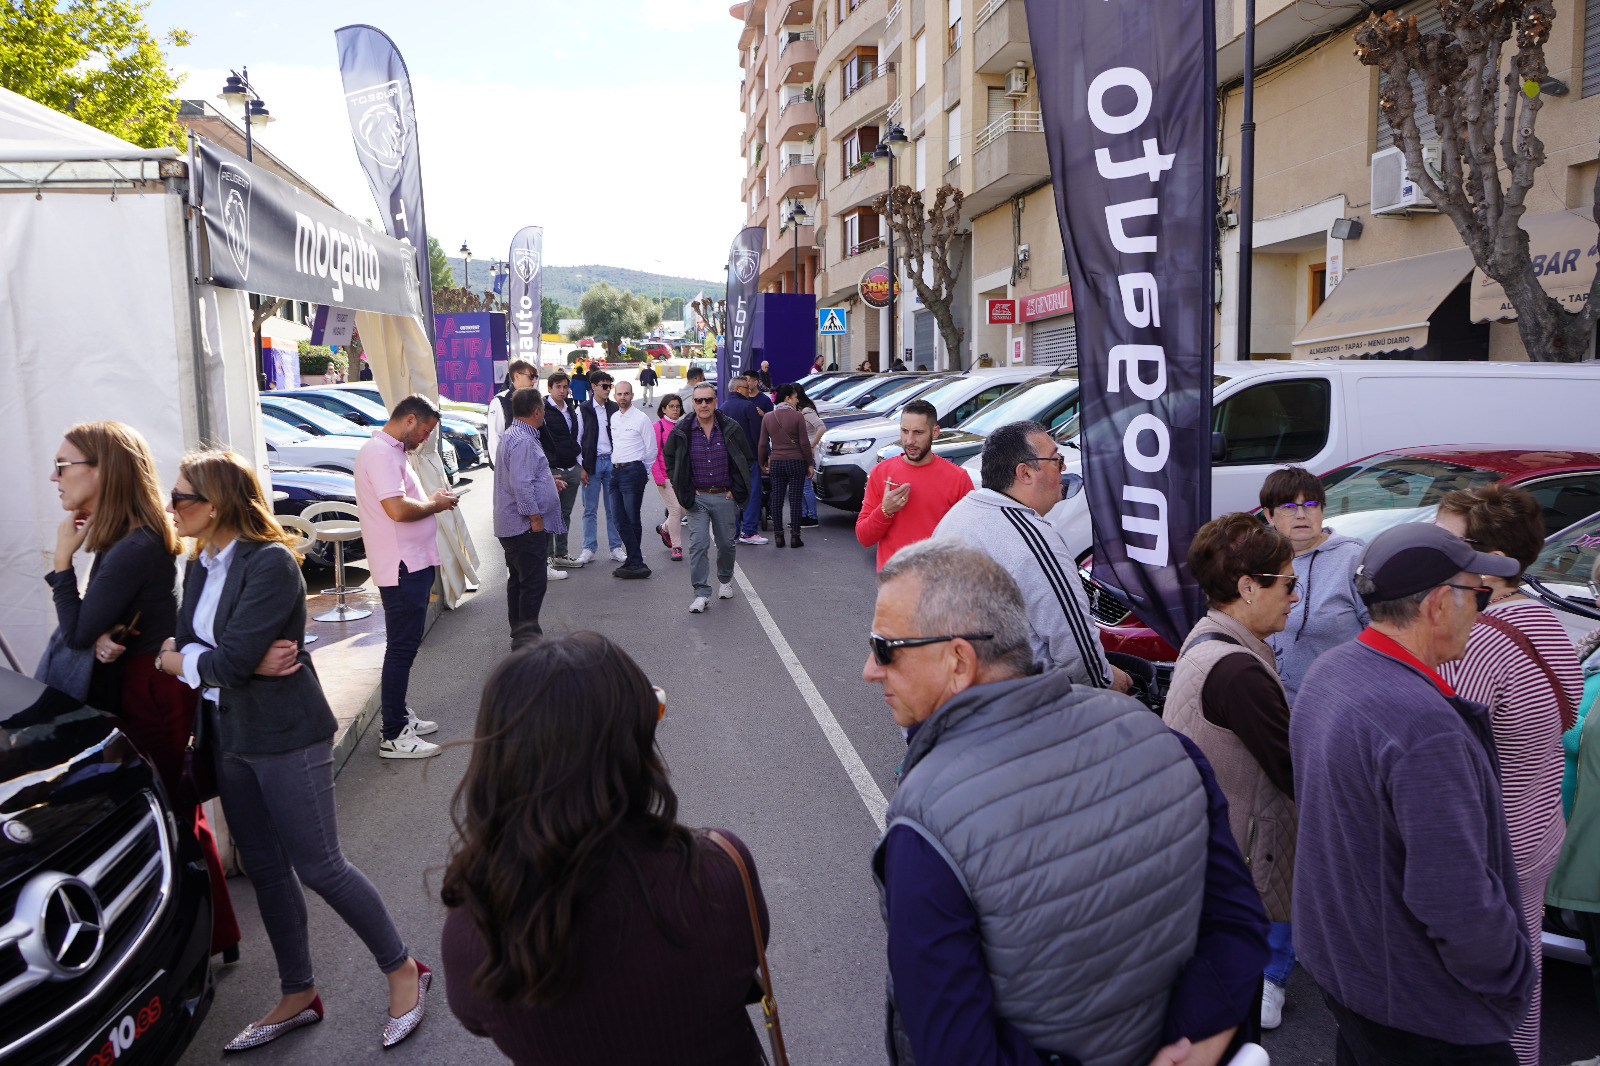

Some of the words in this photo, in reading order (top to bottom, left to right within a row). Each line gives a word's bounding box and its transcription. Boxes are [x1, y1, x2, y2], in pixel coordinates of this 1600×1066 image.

[221, 171, 250, 190] PEUGEOT
[294, 210, 380, 303] mogauto
[1532, 248, 1581, 278] BAR
[1035, 290, 1068, 315] GENERALI
[516, 295, 538, 364] gauto
[731, 295, 747, 378] EUGEOT
[1345, 341, 1363, 351] TAPAS
[1367, 336, 1385, 347] MENÚ
[1387, 336, 1410, 345] DIARIO
